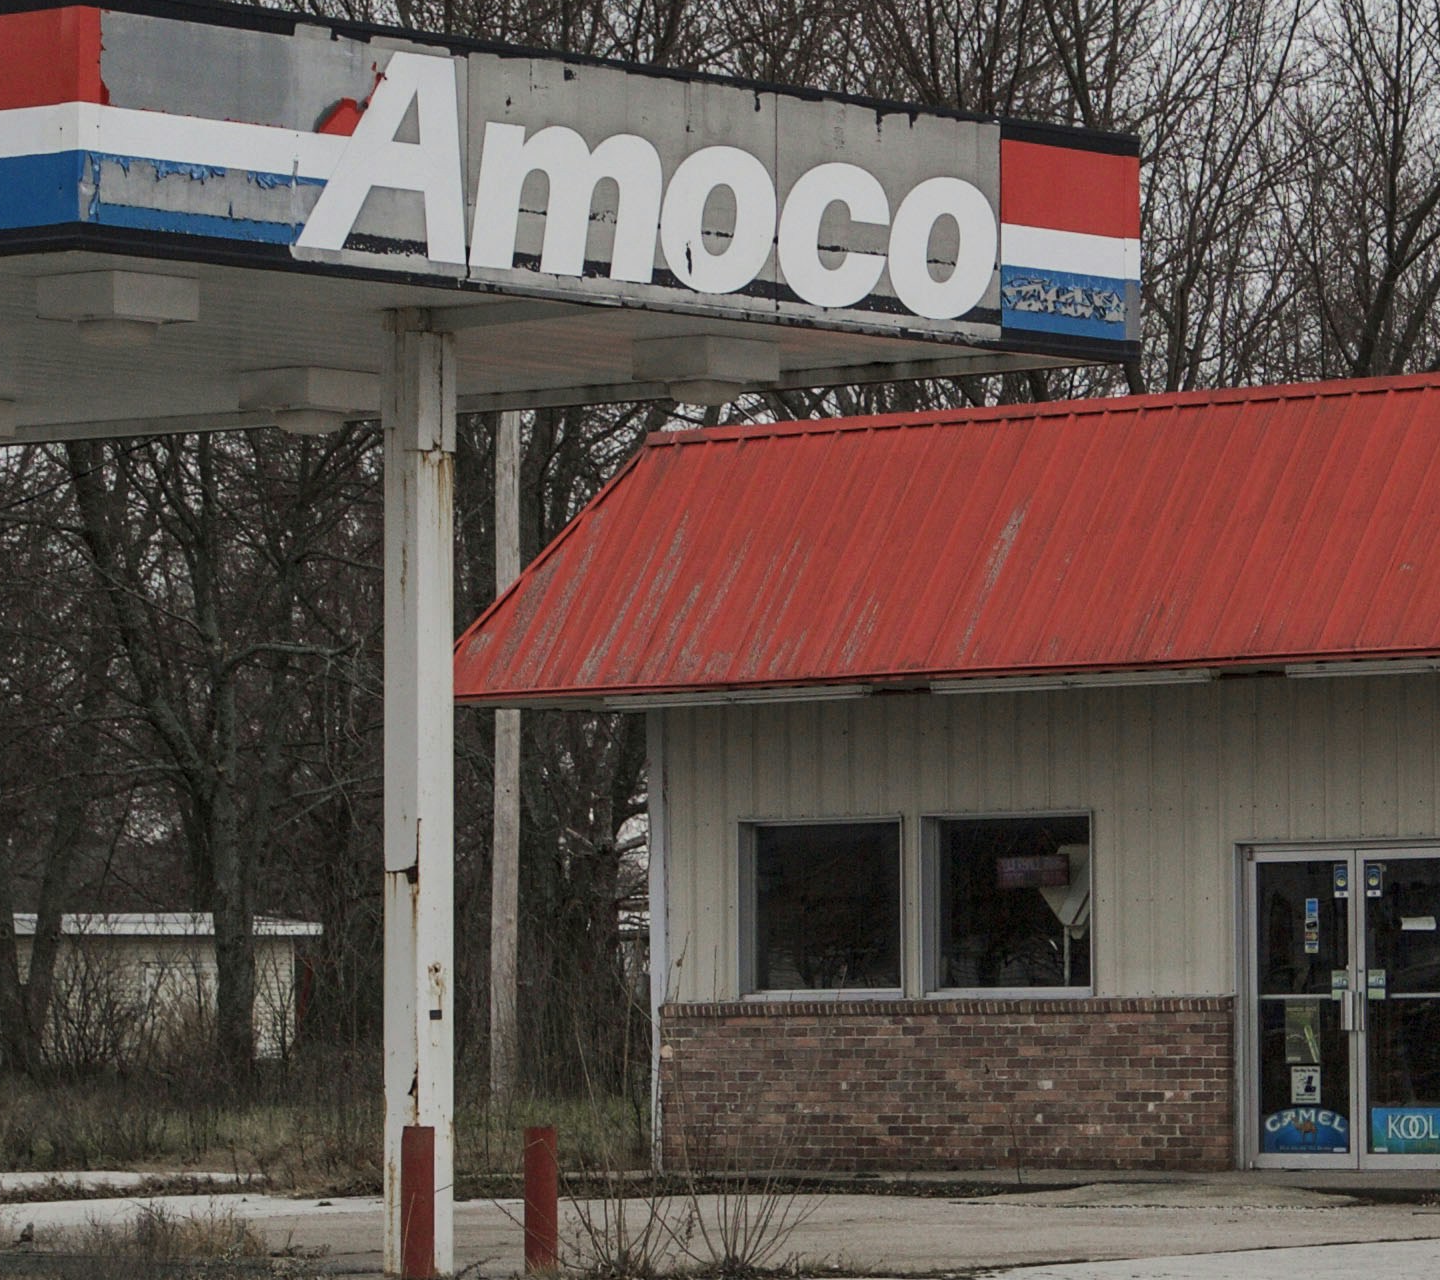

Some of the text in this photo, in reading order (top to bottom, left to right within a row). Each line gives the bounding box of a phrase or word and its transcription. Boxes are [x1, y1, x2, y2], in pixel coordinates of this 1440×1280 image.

[294, 51, 998, 320] Amoco
[1265, 1108, 1346, 1132] CAMEL
[1387, 1114, 1439, 1139] KOOL
